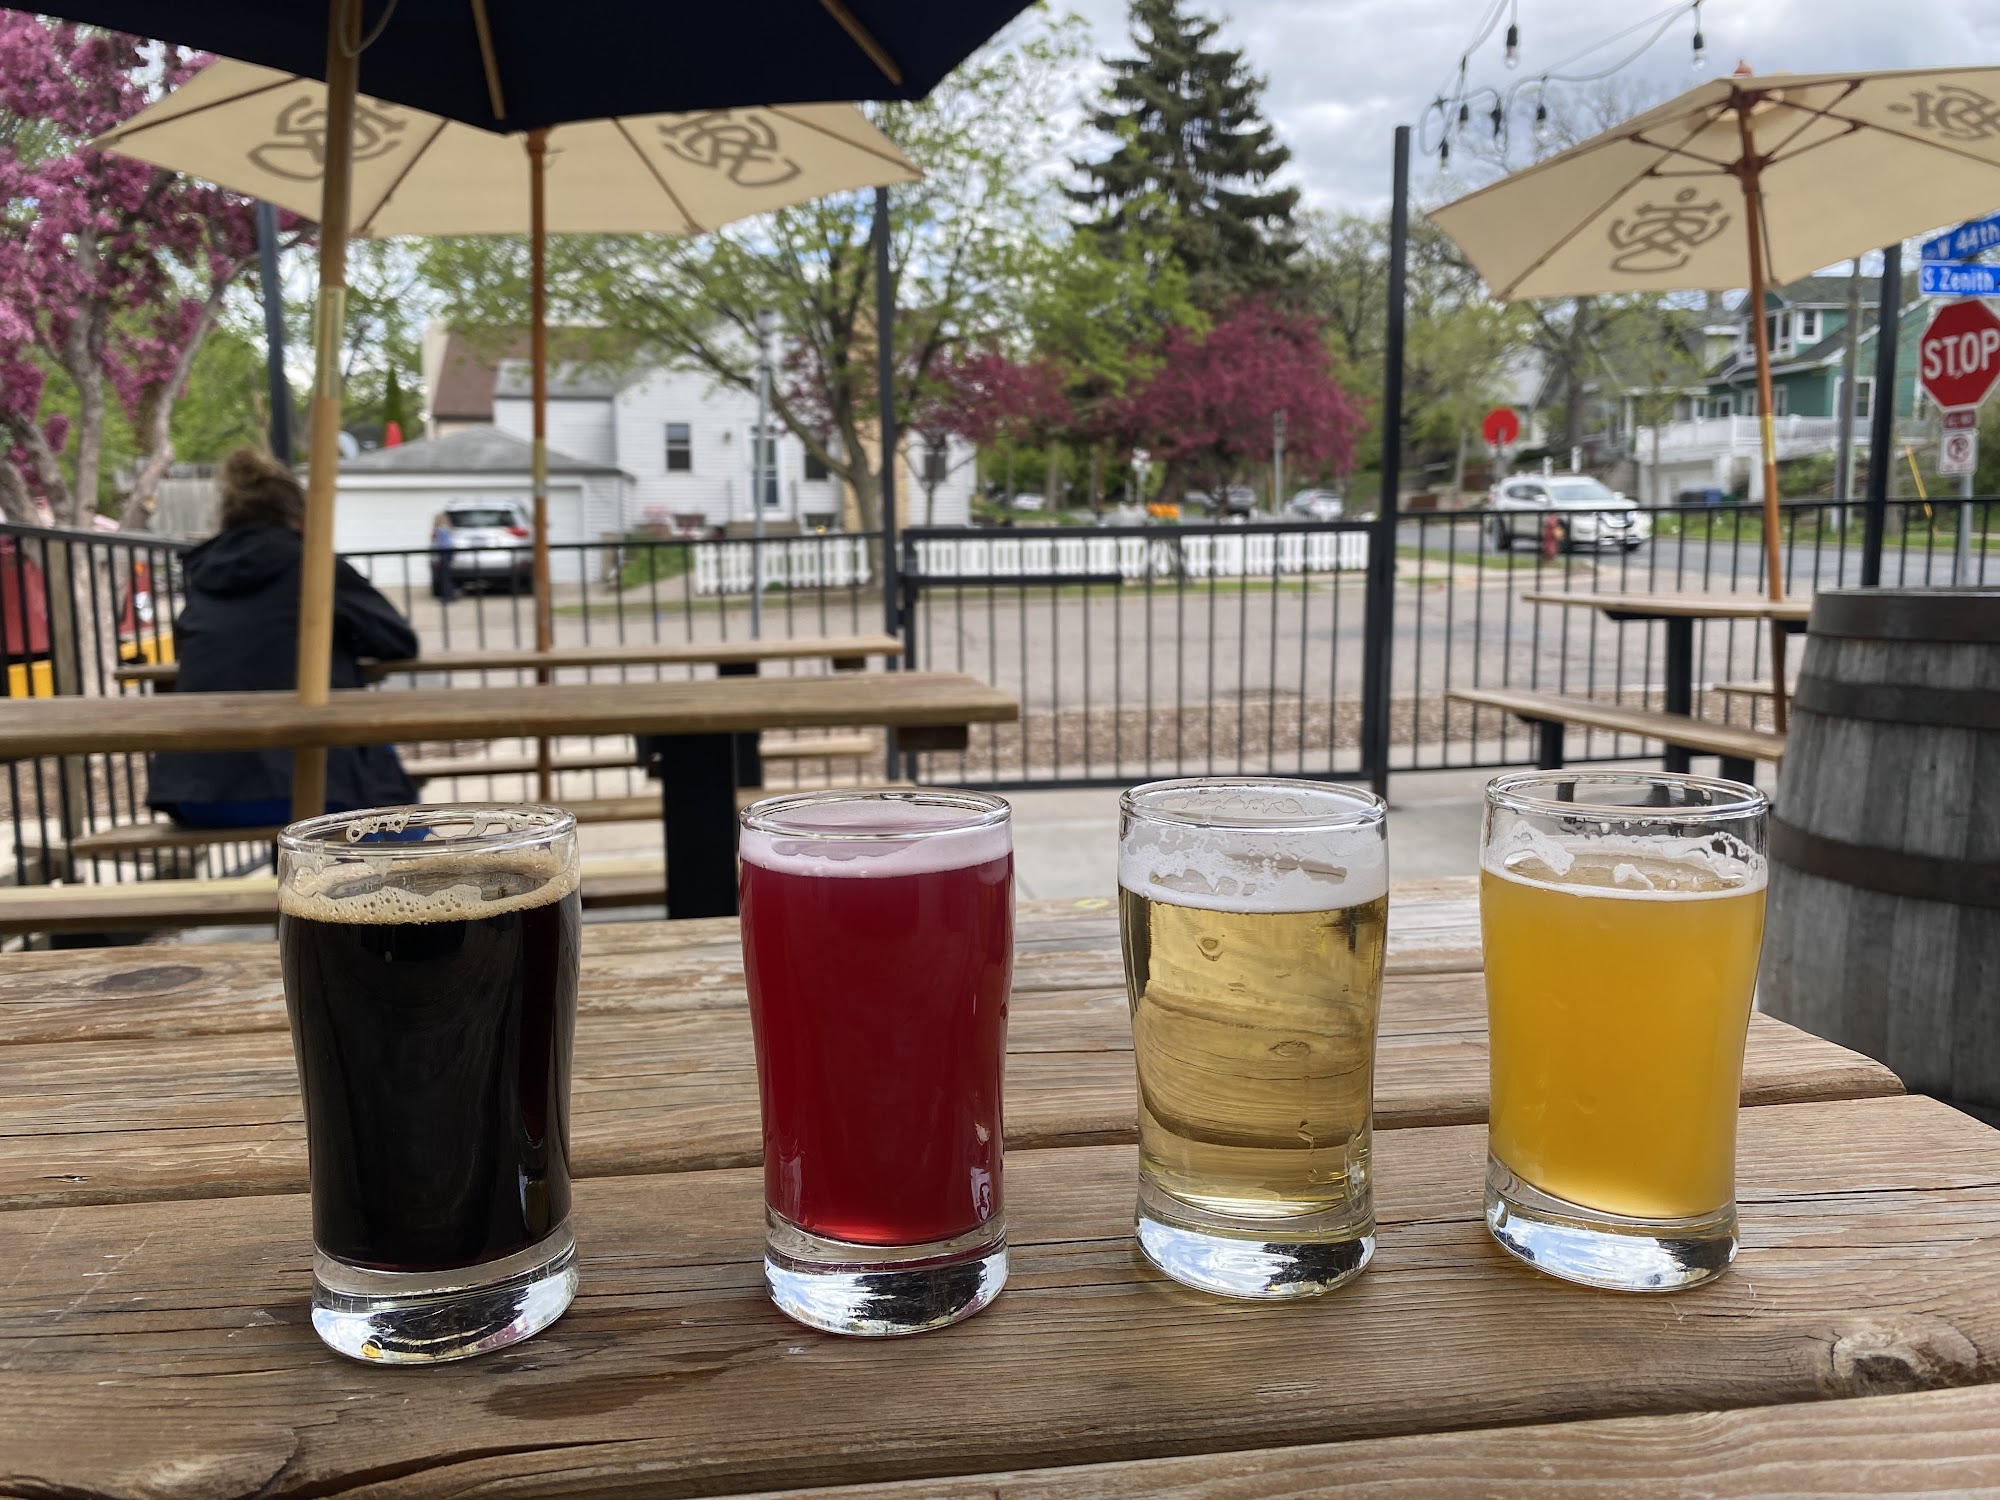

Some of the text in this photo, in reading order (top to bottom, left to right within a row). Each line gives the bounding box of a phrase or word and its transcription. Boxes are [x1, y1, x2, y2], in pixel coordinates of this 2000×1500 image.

[1955, 223, 2000, 252] 44th
[1923, 266, 1995, 292] S Zenith
[1923, 327, 2000, 380] STOP
